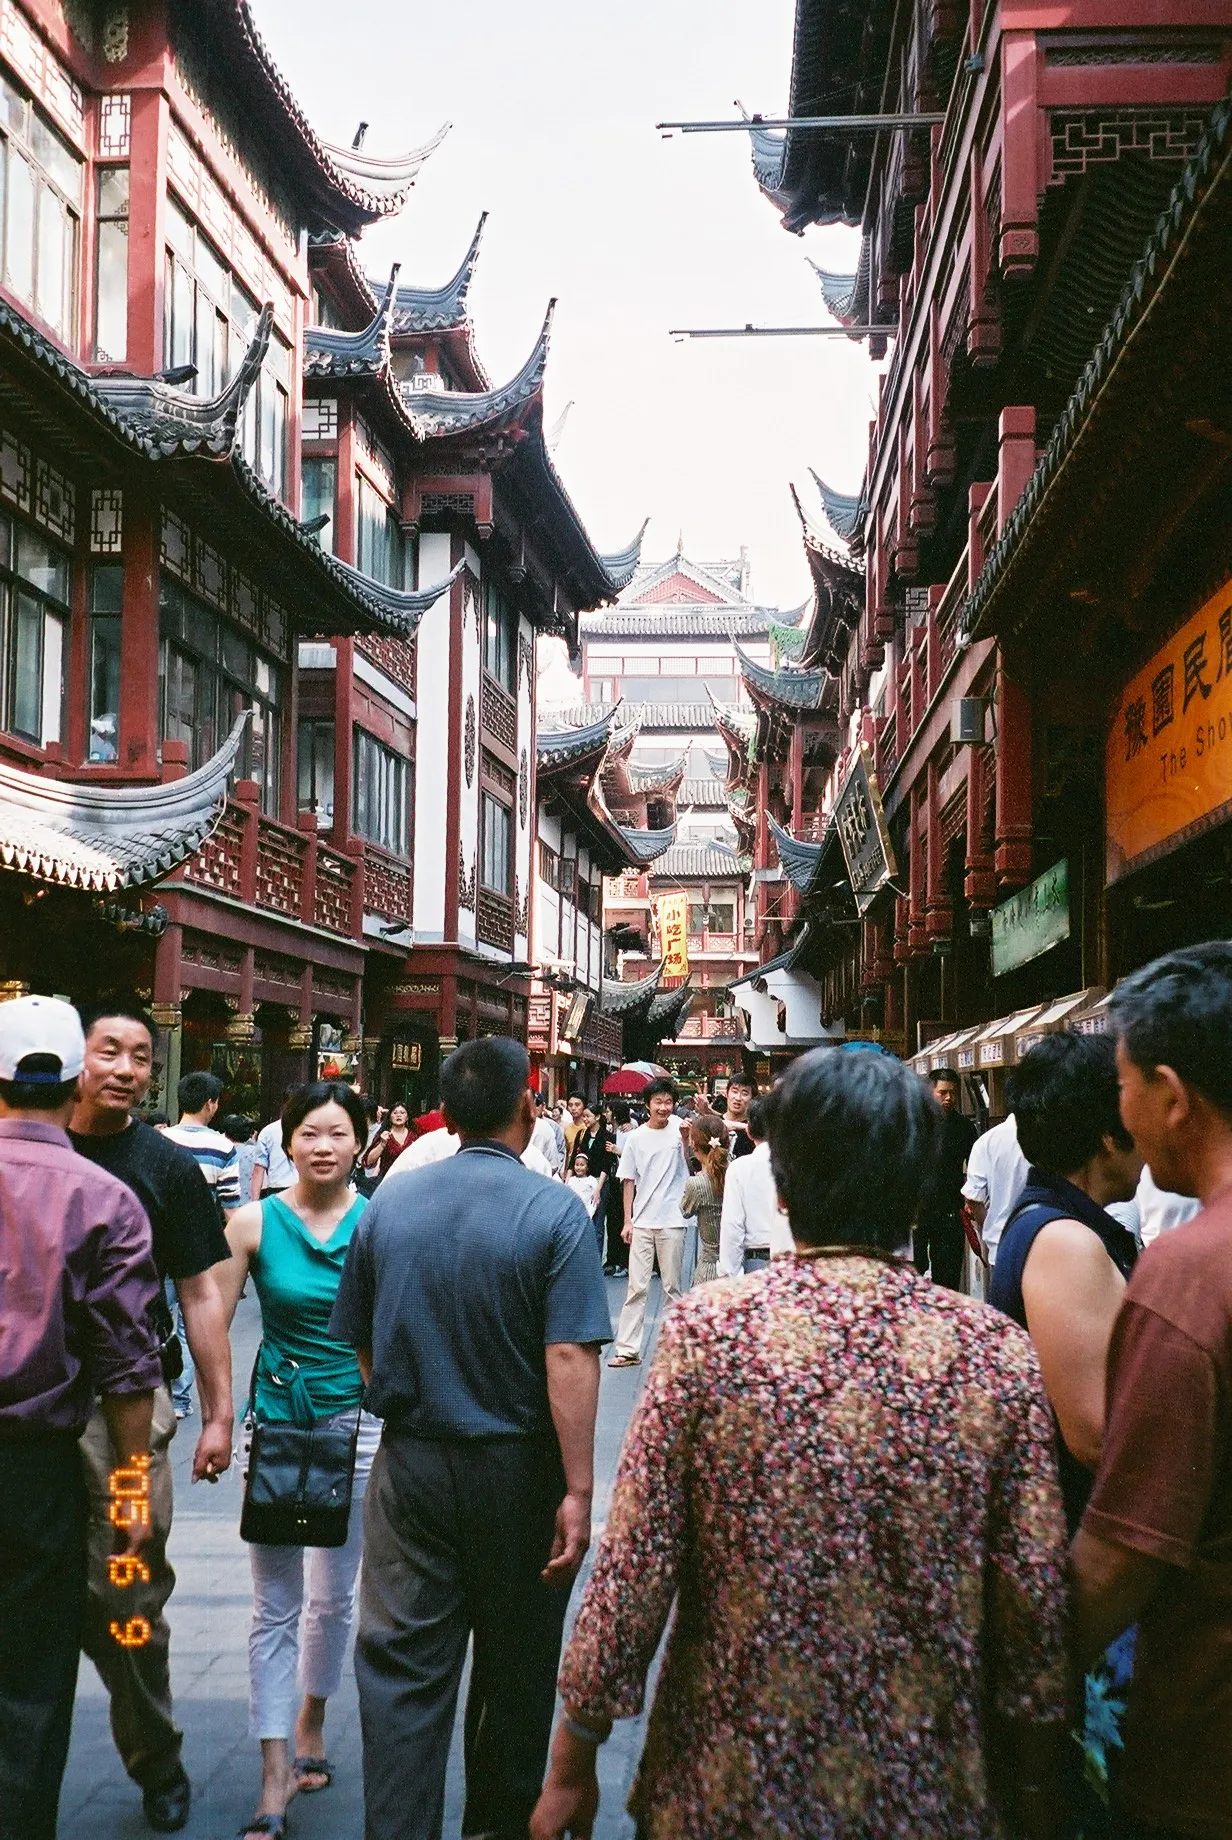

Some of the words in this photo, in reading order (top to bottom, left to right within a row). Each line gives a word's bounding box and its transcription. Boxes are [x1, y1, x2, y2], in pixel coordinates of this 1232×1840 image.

[1160, 747, 1187, 783] The
[1196, 713, 1232, 756] Sho
[665, 909, 683, 965] 小吃广场
